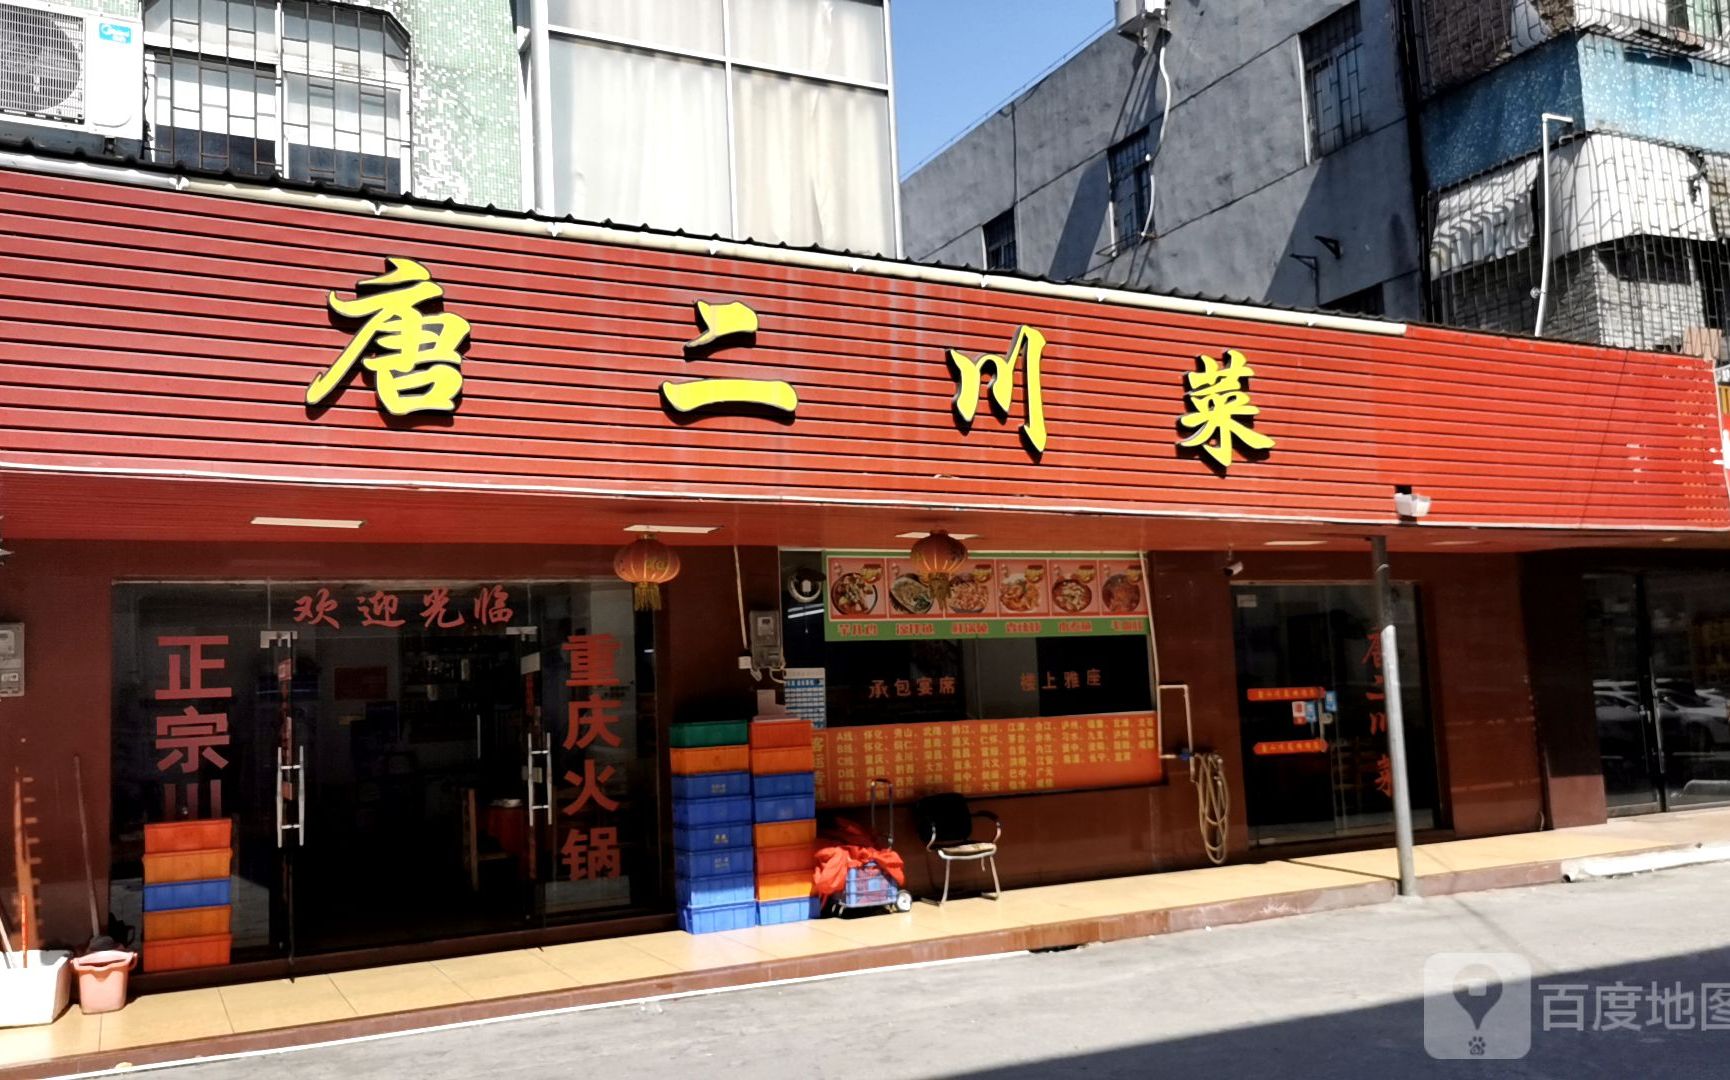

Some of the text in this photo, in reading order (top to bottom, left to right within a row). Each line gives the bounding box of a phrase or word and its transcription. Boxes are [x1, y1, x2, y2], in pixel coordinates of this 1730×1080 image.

[306, 257, 1275, 467] 唐二川菜
[294, 586, 514, 629] 欢迎光临
[868, 676, 956, 699] 承包宴席
[1020, 669, 1102, 692] 楼上雅座
[561, 633, 622, 881] 重庆火锅
